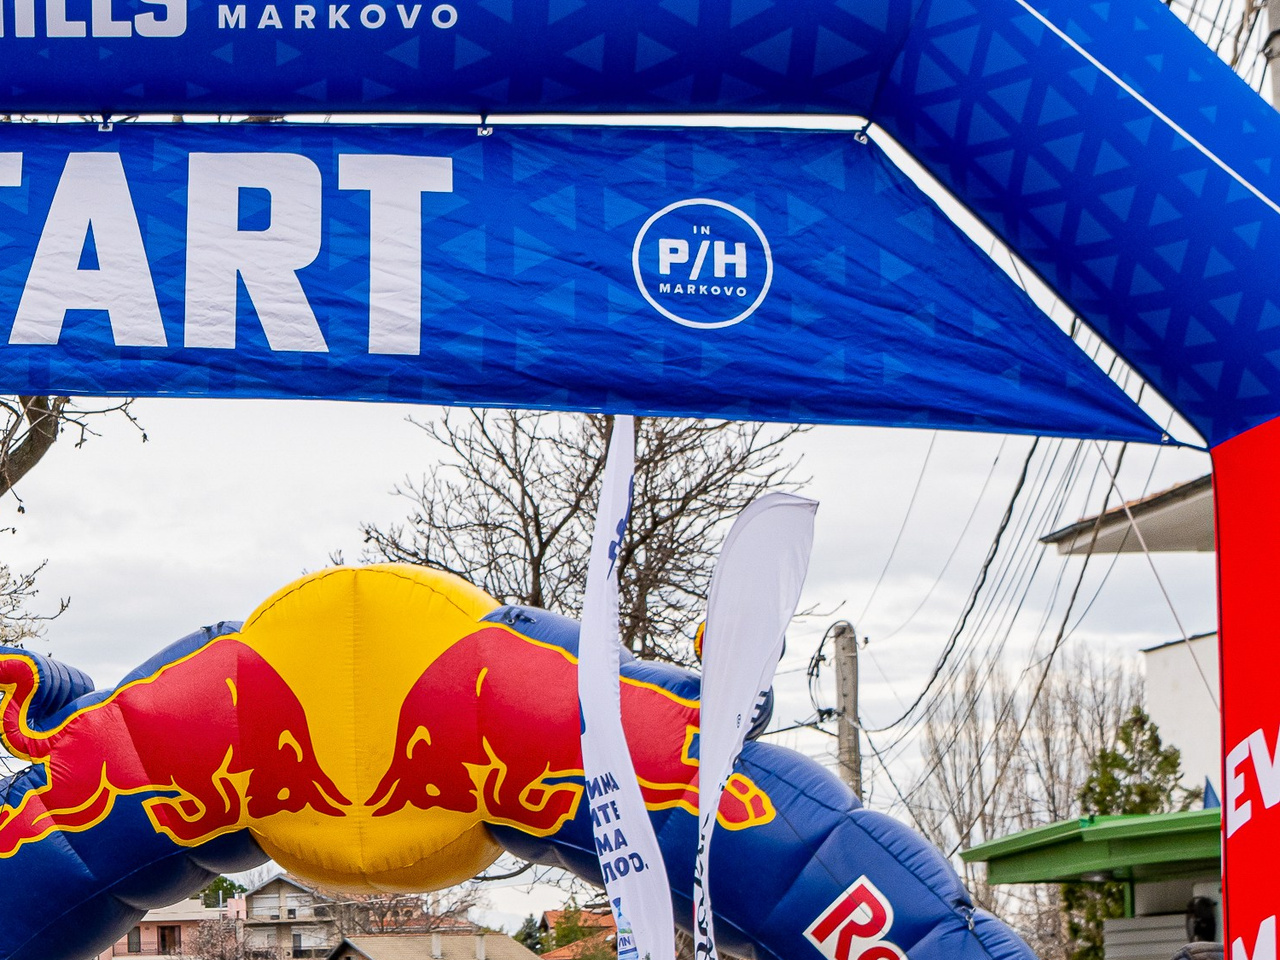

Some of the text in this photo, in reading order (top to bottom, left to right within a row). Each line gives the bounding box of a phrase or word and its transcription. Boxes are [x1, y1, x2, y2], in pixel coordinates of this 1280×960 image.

[217, 3, 459, 30] MARKOVO
[693, 225, 710, 235] IN
[658, 238, 747, 281] P/H
[659, 283, 747, 297] MARKOVO
